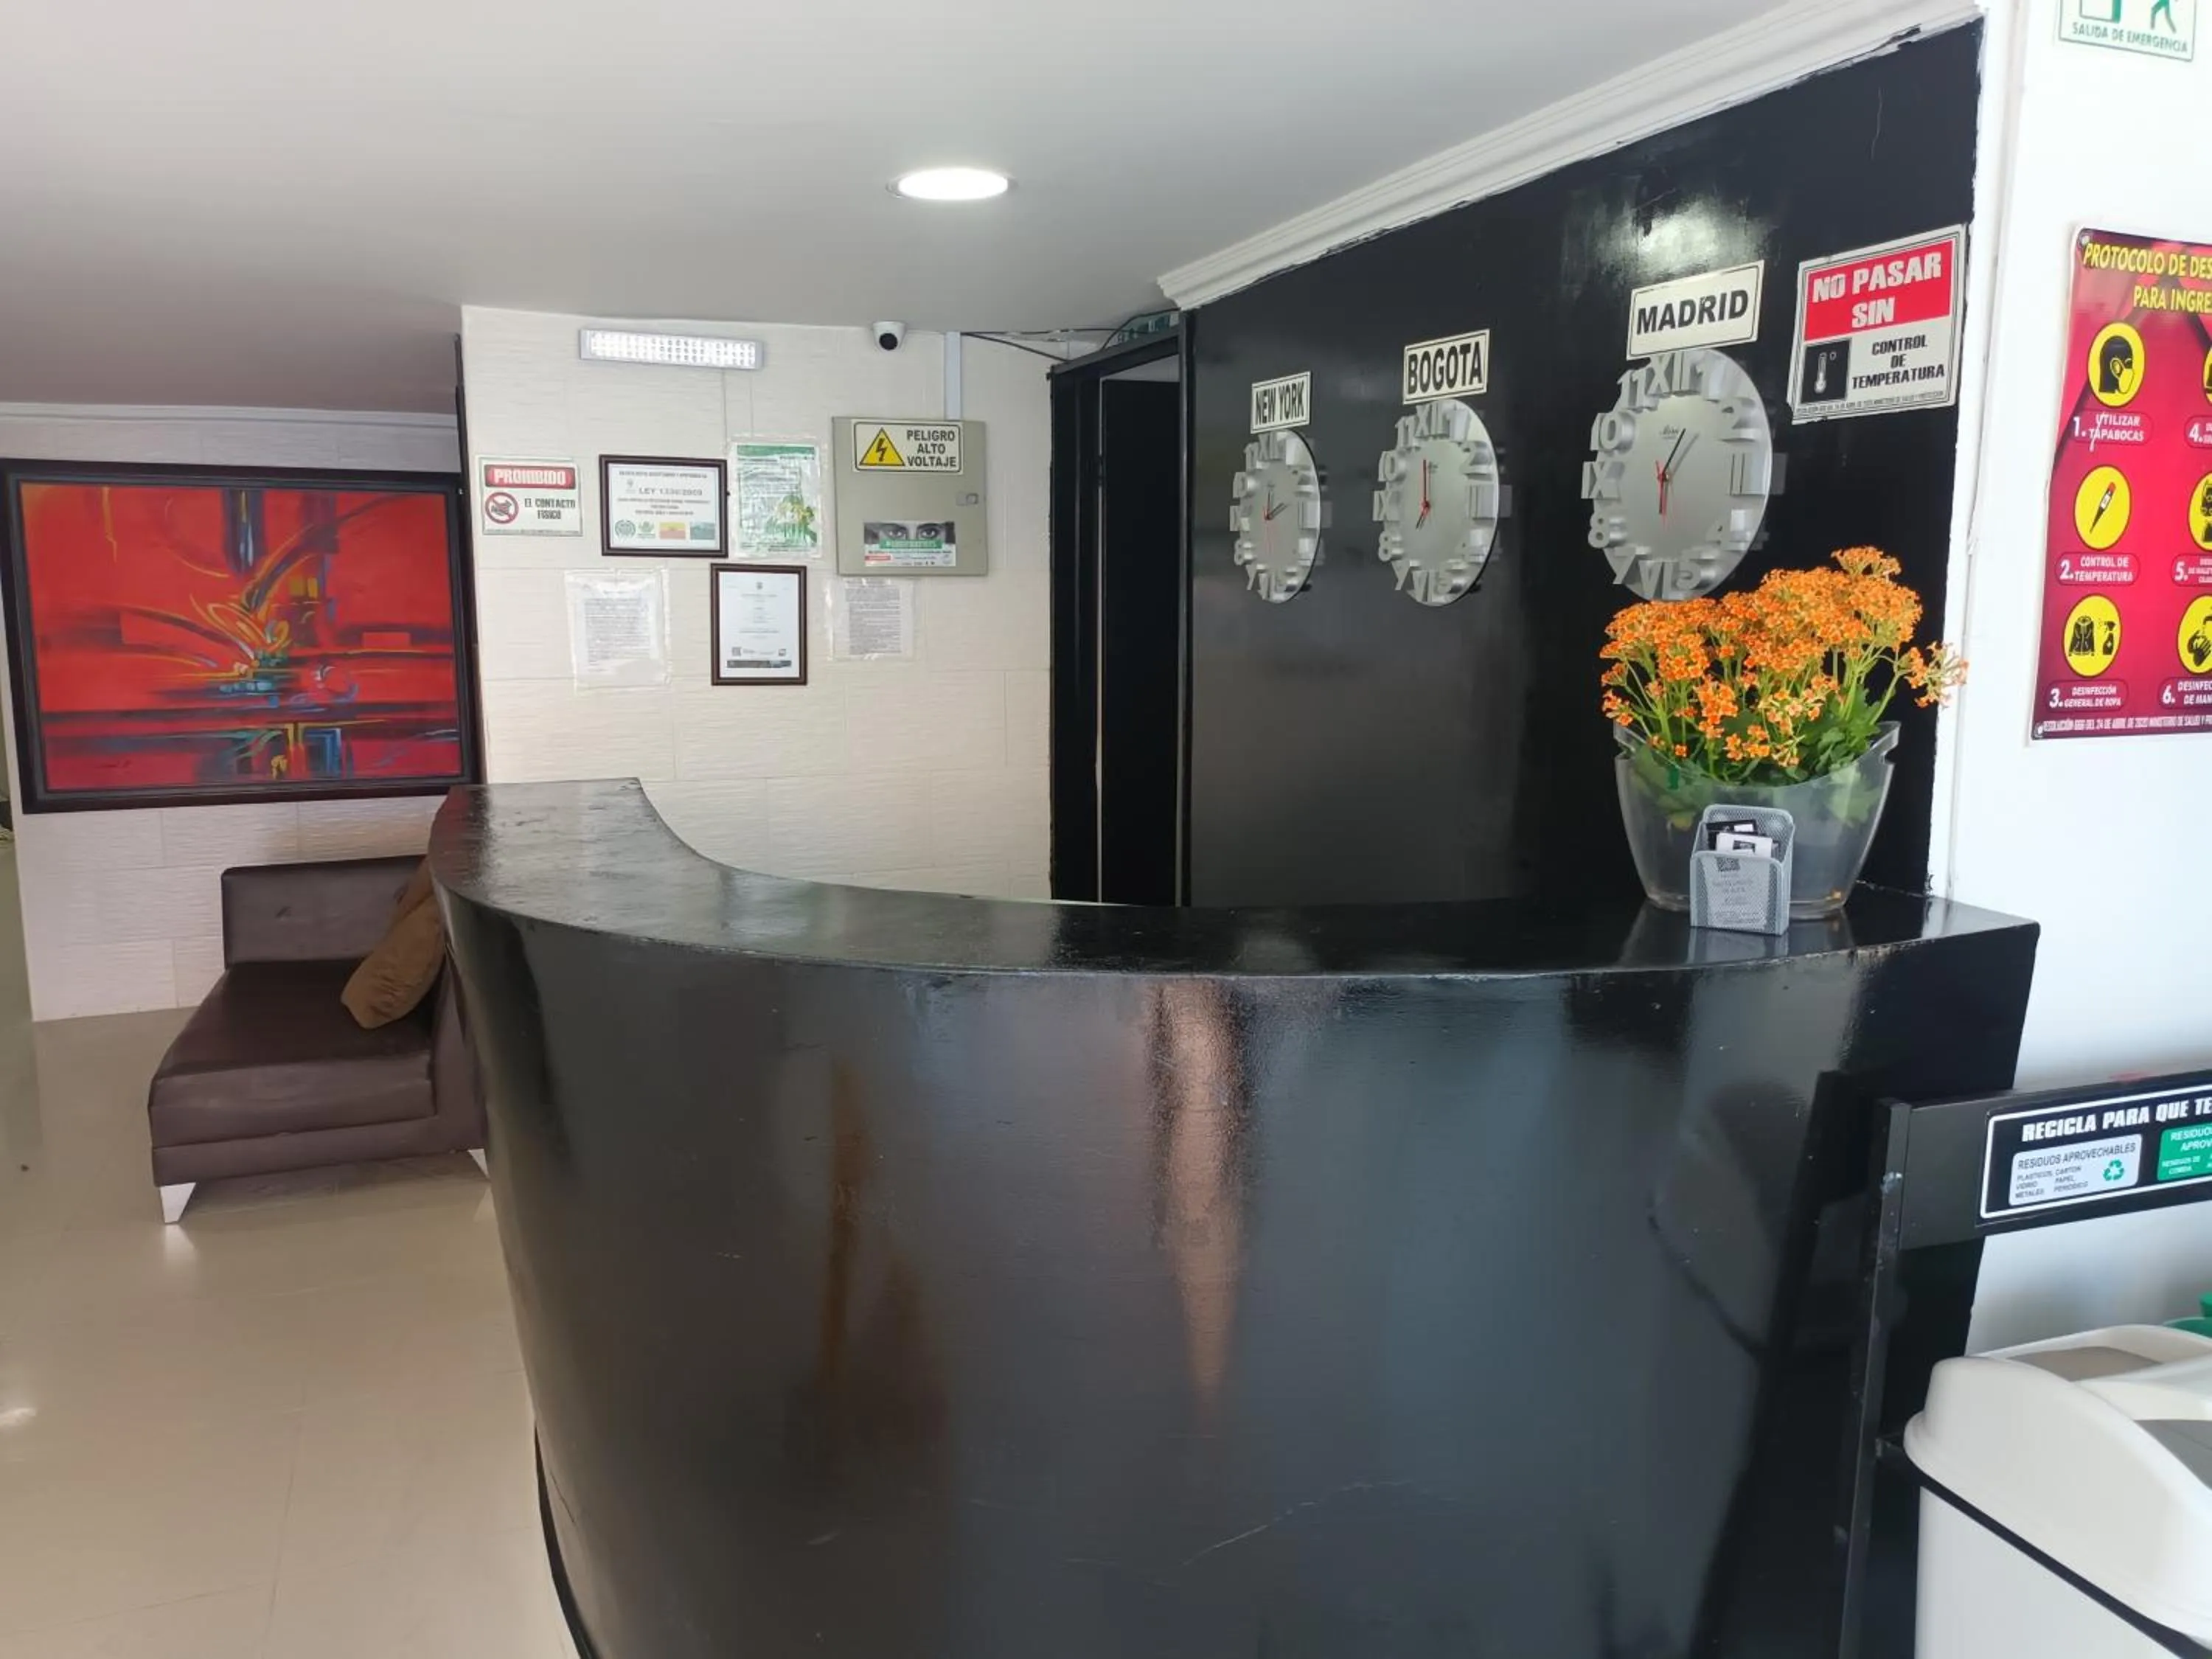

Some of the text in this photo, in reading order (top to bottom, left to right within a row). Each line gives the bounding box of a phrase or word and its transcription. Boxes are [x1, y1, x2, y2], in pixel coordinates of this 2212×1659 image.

[2072, 21, 2188, 53] SALIDA DE EMERGENCIA
[2083, 243, 2212, 279] PROTOCOLO DE DES
[1812, 252, 1941, 304] NO PASAR
[2133, 285, 2212, 313] PARA INGRE
[1636, 289, 1749, 335] MADRID
[1851, 296, 1895, 329] SIN
[1872, 335, 1927, 356] CONTROL
[1408, 341, 1482, 394] BOGOTA
[1891, 354, 1906, 369] DE
[1852, 364, 1945, 390] TEMPERATURA
[1256, 380, 1304, 425] NEW YORK
[907, 430, 955, 441] PELIGRO
[2073, 416, 2087, 437] 1.
[2088, 428, 2145, 442] TAPABOCAS
[917, 443, 945, 454] ALTO
[907, 456, 956, 467] VOLTAJE
[493, 468, 566, 486] PROHIBIDO
[524, 498, 575, 508] EL CONTACTO
[2059, 559, 2074, 580] 2.
[2080, 556, 2129, 567] CONTROL DE
[2074, 571, 2133, 582] TEMPERATURA
[2049, 688, 2064, 708] 3.
[2022, 1097, 2212, 1142] RECICLA PARA QUE TE
[2170, 1127, 2212, 1141] RESIDUO
[2018, 1142, 2136, 1169] RESIDUOS APROVECHABLES
